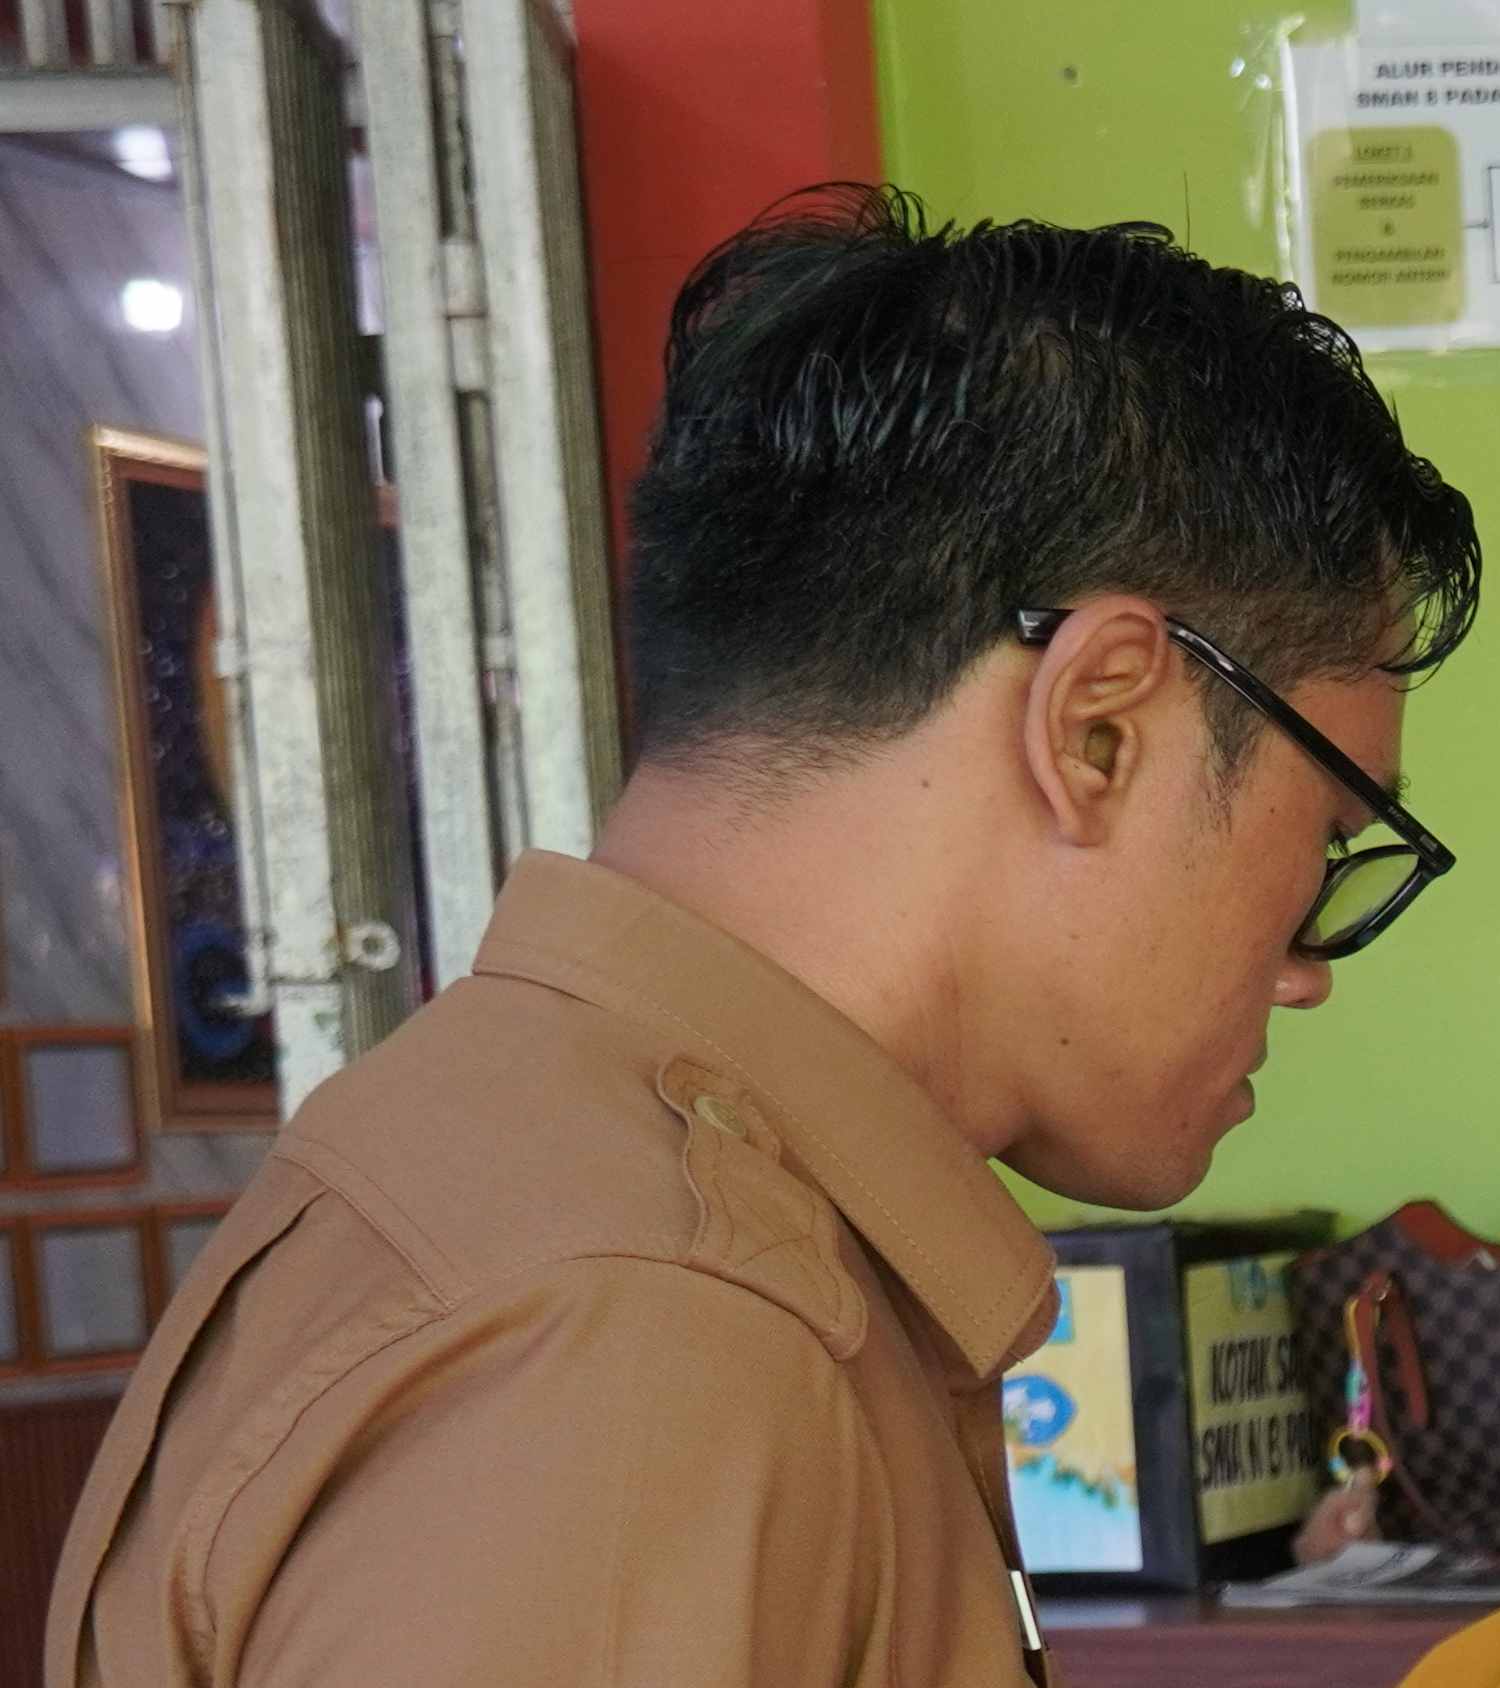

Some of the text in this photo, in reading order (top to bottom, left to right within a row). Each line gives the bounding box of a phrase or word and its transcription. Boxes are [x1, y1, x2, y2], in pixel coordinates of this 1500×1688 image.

[1376, 61, 1432, 80] ALUR
[1356, 91, 1419, 108] SMAN
[1211, 1336, 1268, 1403] KOTAK
[1201, 1422, 1246, 1490] SMA
[1249, 1416, 1264, 1480] N
